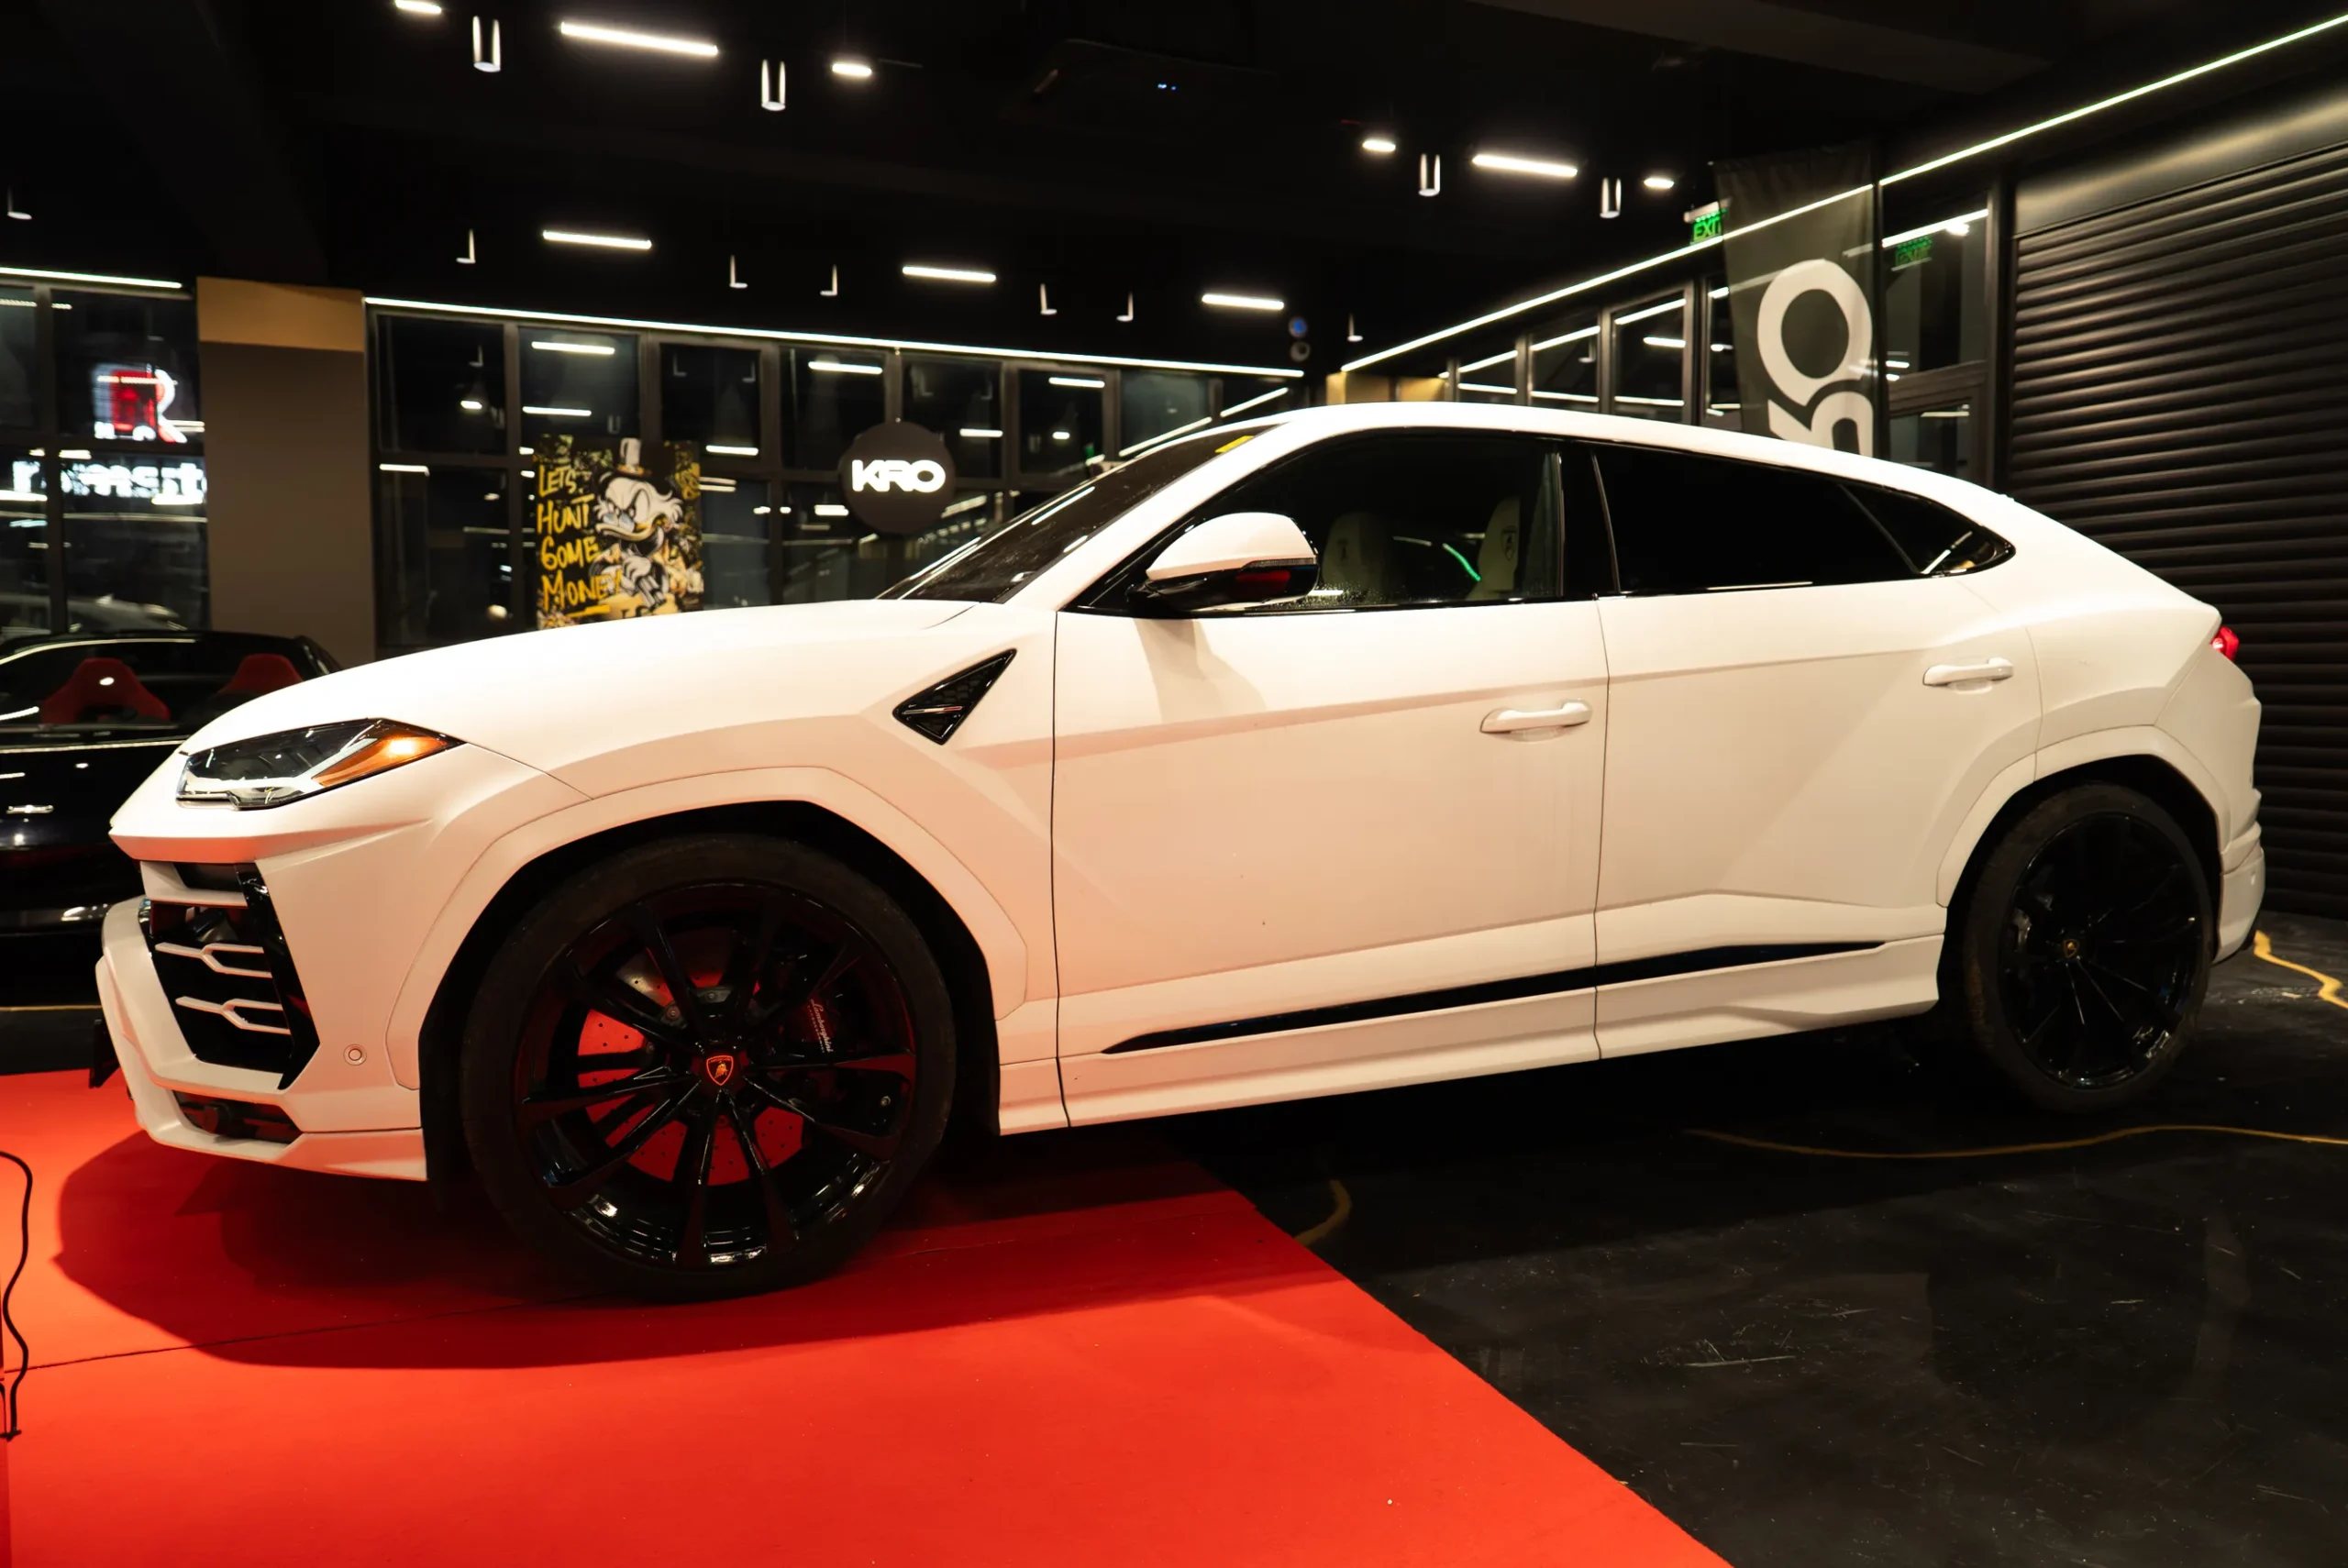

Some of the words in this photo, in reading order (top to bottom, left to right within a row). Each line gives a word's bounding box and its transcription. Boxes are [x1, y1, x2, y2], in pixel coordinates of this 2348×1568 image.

[851, 459, 946, 492] KRO
[537, 493, 595, 535] HUNT
[541, 569, 623, 613] MONEY
